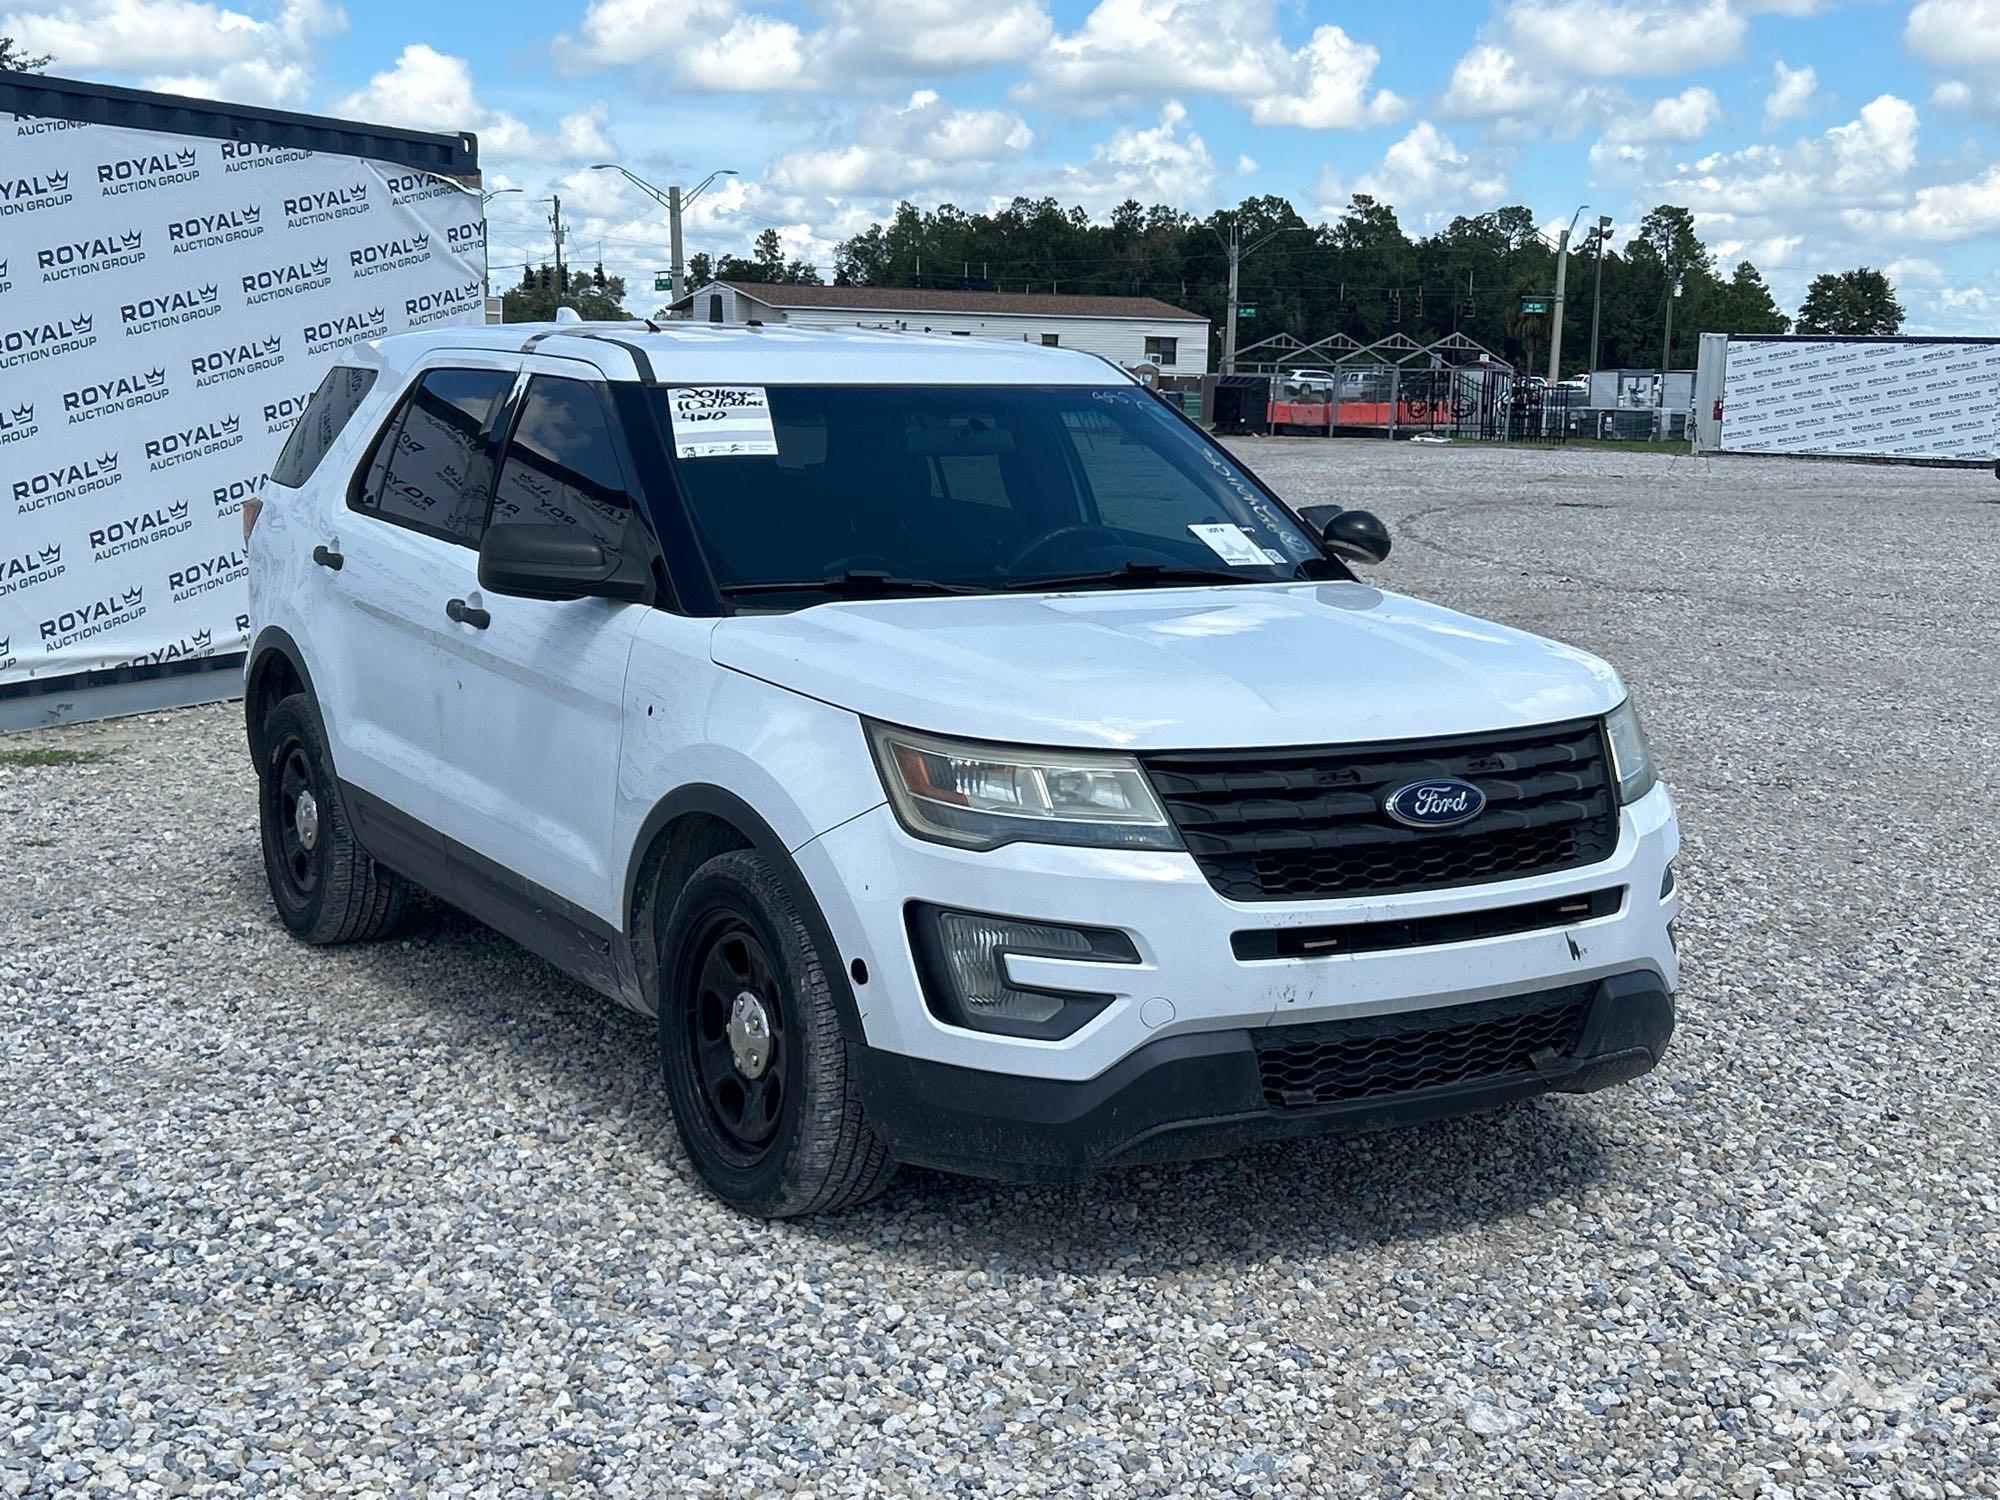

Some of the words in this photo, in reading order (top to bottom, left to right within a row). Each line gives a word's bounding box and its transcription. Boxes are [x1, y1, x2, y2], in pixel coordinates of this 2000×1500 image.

[17, 120, 76, 137] AUCTION
[97, 154, 178, 183] ROYAL
[225, 158, 274, 174] AUCTION
[275, 150, 313, 164] GROUP
[0, 177, 48, 201] YAL
[102, 179, 157, 197] AUCTION
[159, 170, 200, 186] GROUP
[387, 173, 439, 194] ROYA
[26, 194, 73, 212] GROUP
[284, 189, 351, 217] ROYAL
[392, 191, 432, 206] AUCTION
[168, 211, 243, 241] ROYAL
[287, 211, 334, 230] AUCTION
[335, 203, 370, 219] GROUP
[172, 236, 224, 255] AUCTION
[225, 226, 264, 243] GROUP
[447, 221, 483, 243] ROY
[38, 237, 122, 269] ROYAL
[350, 239, 413, 267] ROYAL
[452, 240, 484, 254] AUCTIO
[42, 262, 100, 283] AUCTION
[102, 252, 146, 270] GROUP
[242, 264, 312, 293] ROYAL
[353, 262, 397, 279] AUCTION
[398, 252, 431, 268] GROUP
[246, 286, 294, 306] AUCTION
[295, 278, 332, 294] GROUP
[405, 288, 465, 316] ROYAL
[120, 290, 200, 324] ROYAL
[125, 315, 180, 336] AUCTION
[182, 304, 222, 323] GROUP
[408, 310, 450, 328] AUCTION
[451, 300, 482, 316] GROUP
[304, 313, 369, 344] ROYAL
[308, 336, 353, 356] AUCTION
[354, 326, 388, 342] GROUP
[0, 348, 50, 369] UCTION
[52, 336, 97, 356] GROUP
[191, 343, 264, 376] ROYAL
[196, 368, 246, 389] AUCTION
[247, 355, 285, 373] GROUP
[63, 375, 146, 412] ROYAL
[68, 402, 125, 425] AUCTION
[126, 388, 170, 409] GROUP
[0, 426, 38, 446] ROUP
[144, 423, 222, 460] ROYAL
[150, 449, 203, 472] AUCTION
[204, 435, 244, 455] GROUP
[12, 461, 98, 500] ROYAL
[18, 490, 76, 515] AUCTION
[78, 474, 122, 495] GROUP
[90, 509, 170, 549] ROYAL
[94, 536, 149, 562] AUCTION
[151, 520, 192, 542] GROUP
[20, 565, 66, 589] GROUP
[168, 552, 245, 591] ROYAL
[172, 576, 225, 604] AUCTION
[225, 566, 249, 583] GRO
[40, 596, 124, 640] ROYAL
[46, 623, 101, 654] AUCTION
[104, 606, 147, 630] GROUP
[1415, 787, 1468, 815] Ford
